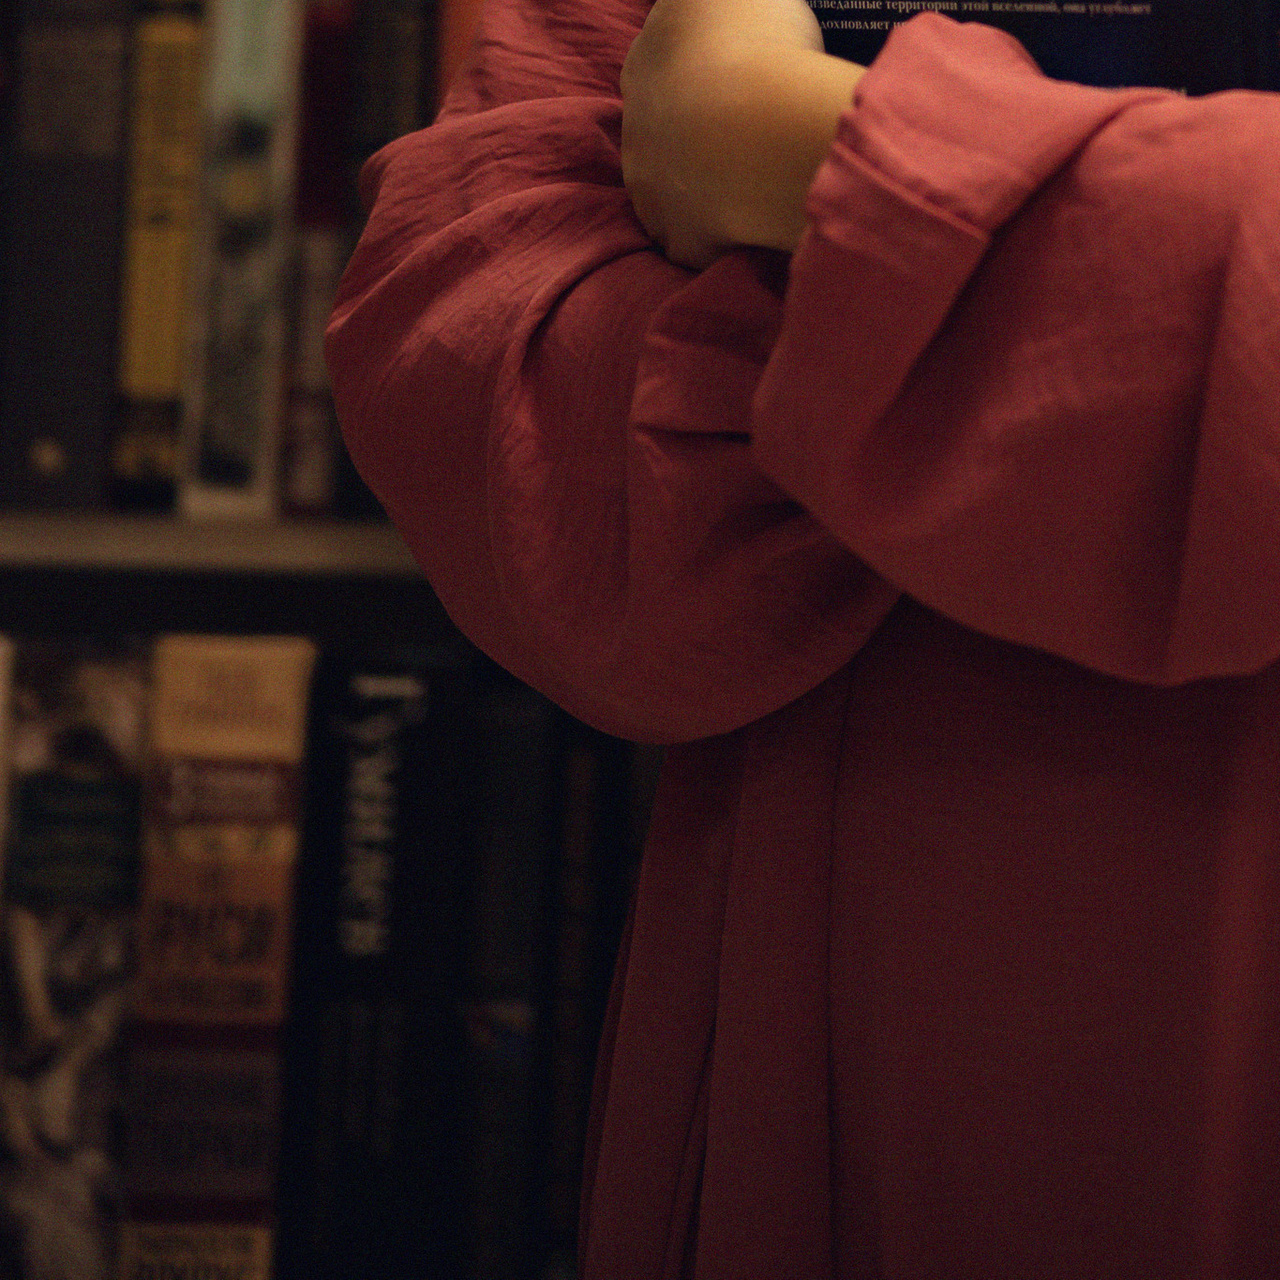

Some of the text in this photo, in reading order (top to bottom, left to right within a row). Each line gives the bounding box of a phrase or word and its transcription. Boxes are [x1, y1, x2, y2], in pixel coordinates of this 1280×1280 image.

[807, 0, 882, 11] изведанные
[885, 0, 957, 13] территории
[820, 19, 889, 30] дохновляет
